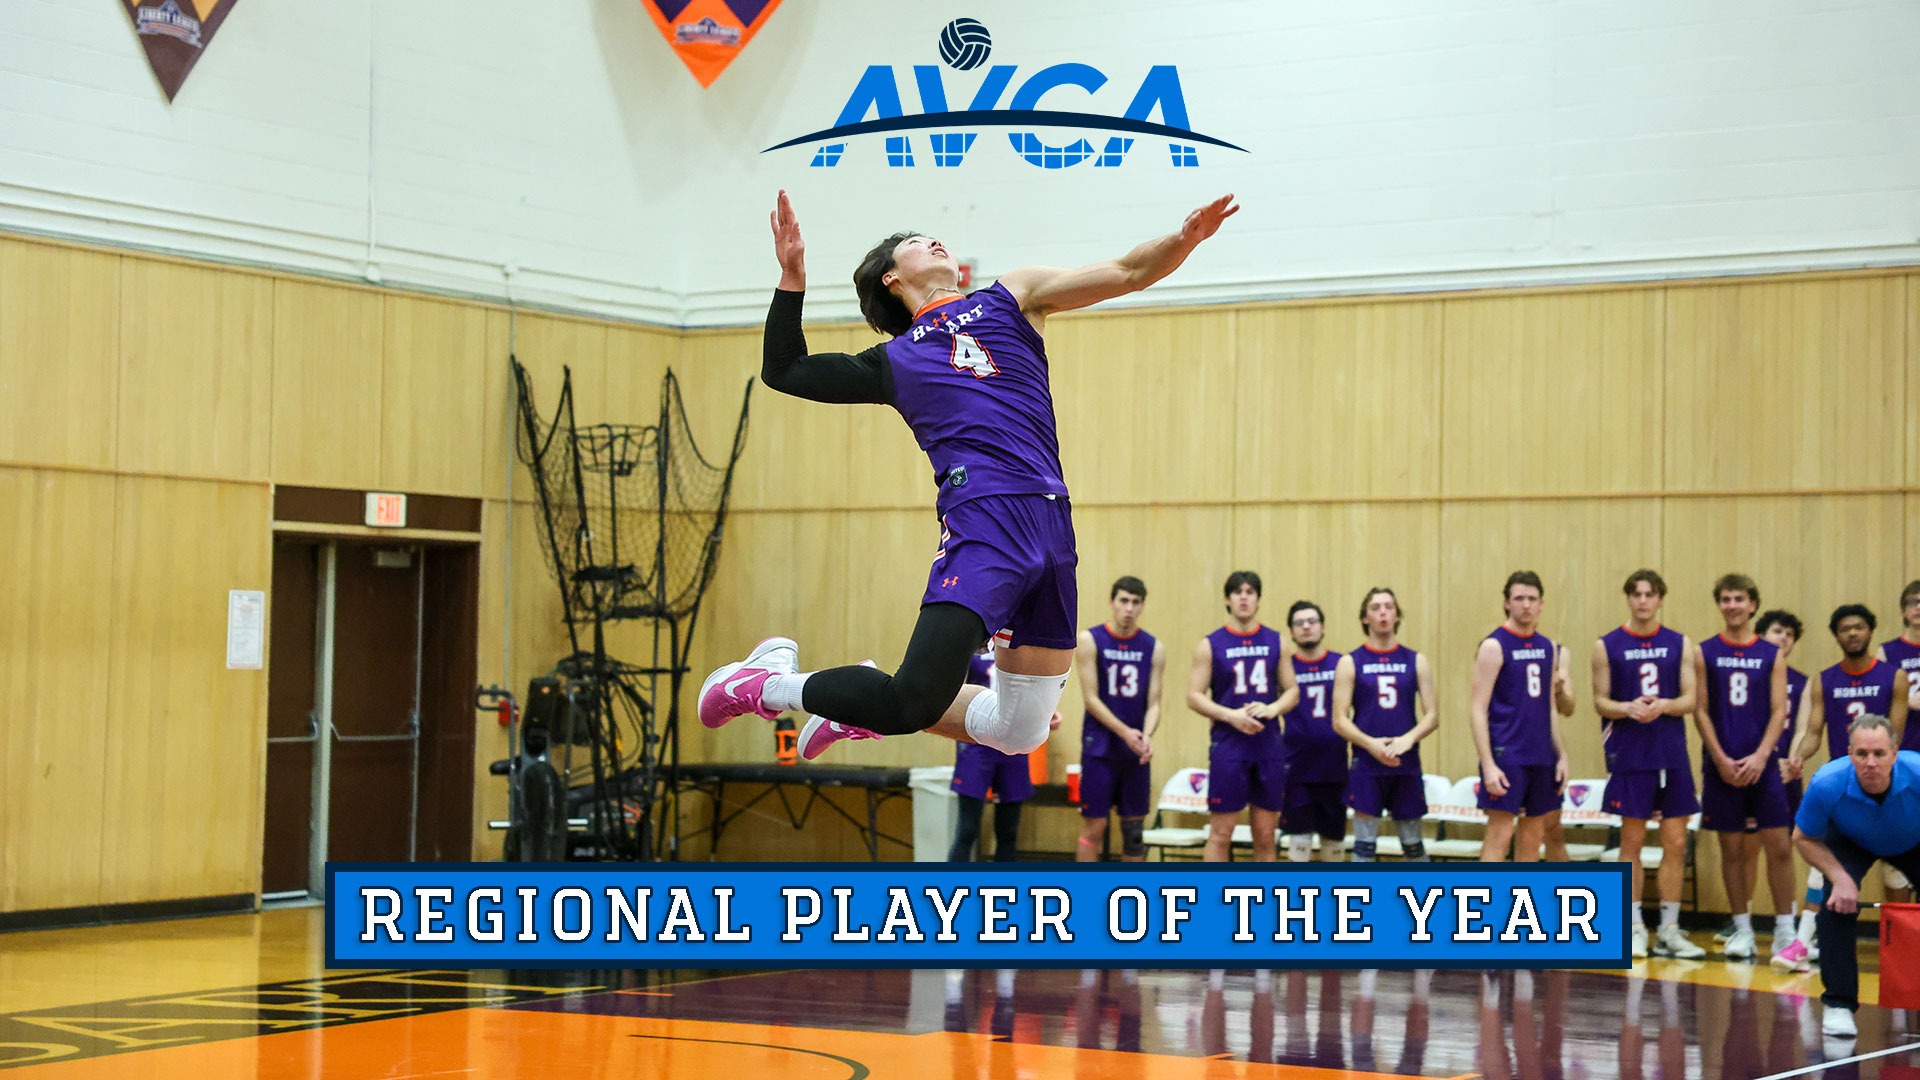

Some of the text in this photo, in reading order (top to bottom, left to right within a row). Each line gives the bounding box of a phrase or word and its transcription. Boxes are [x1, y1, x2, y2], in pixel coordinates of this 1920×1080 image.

[950, 331, 1001, 378] 4
[1225, 646, 1270, 659] HOBART
[1362, 663, 1407, 674] HOBART
[1624, 647, 1669, 660] HOBART
[1716, 656, 1763, 669] HOBART
[1107, 663, 1139, 697] 13
[1233, 659, 1268, 694] 14
[1376, 675, 1398, 709] 5
[1526, 663, 1541, 698] 6
[1639, 662, 1660, 697] 2
[1729, 671, 1749, 706] 8
[1833, 685, 1880, 698] HOBART
[1306, 685, 1327, 718] 7
